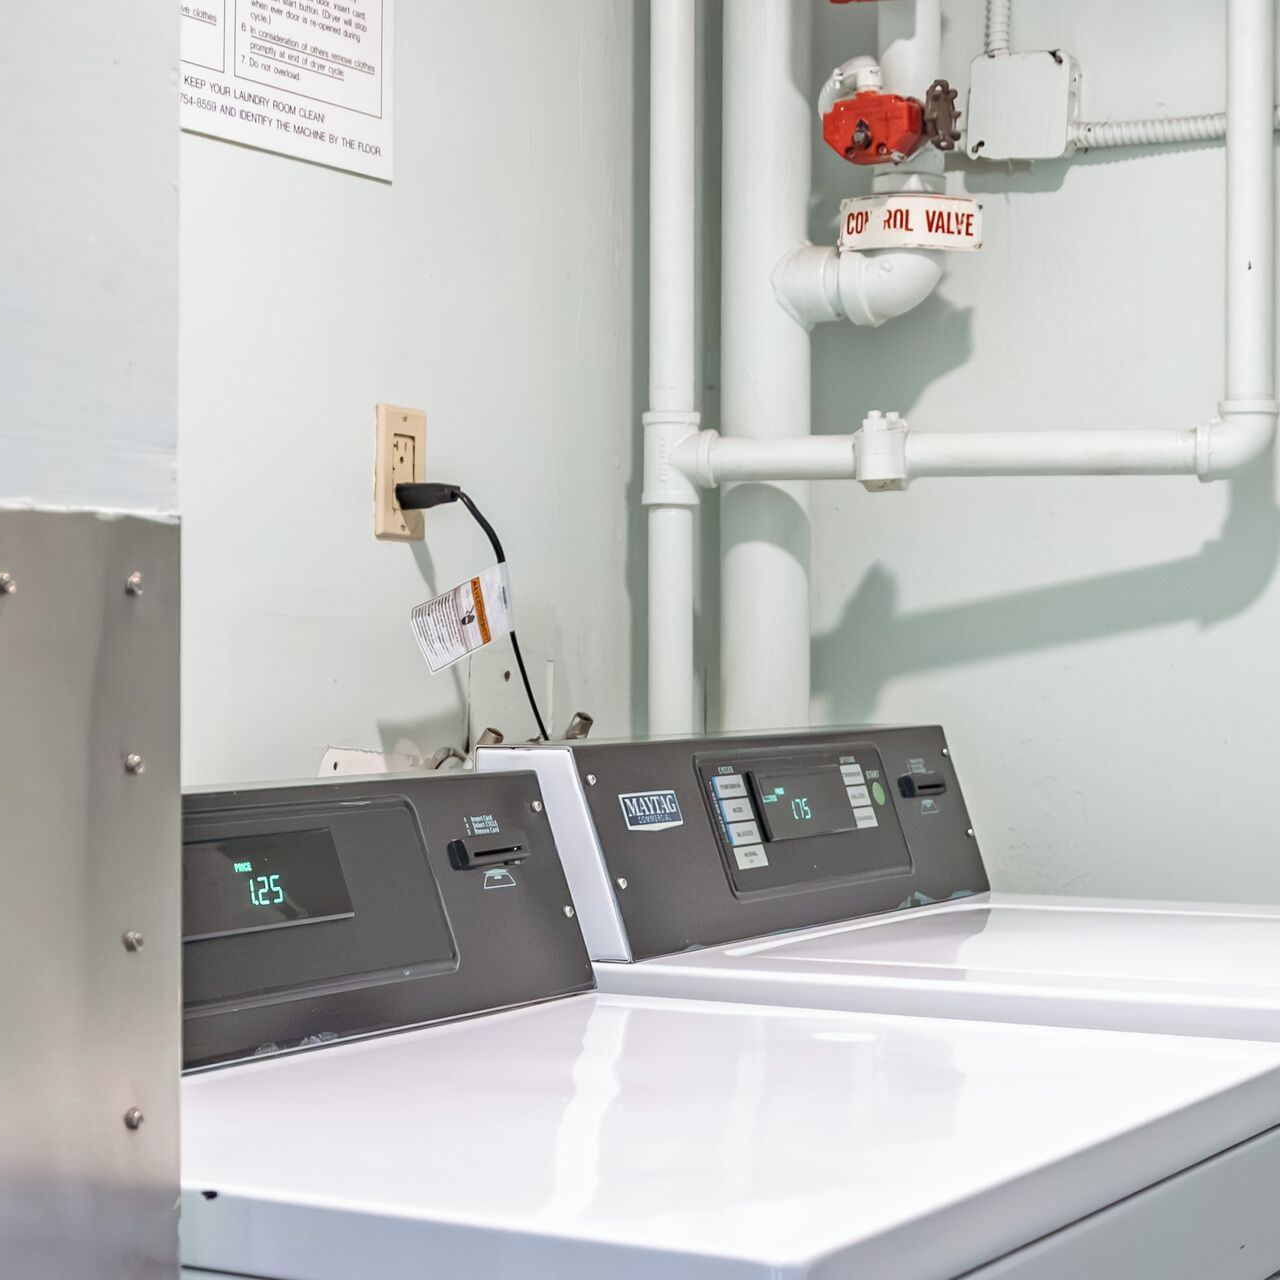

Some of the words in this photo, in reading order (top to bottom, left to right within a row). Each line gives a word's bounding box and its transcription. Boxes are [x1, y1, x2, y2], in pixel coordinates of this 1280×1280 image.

[192, 7, 217, 23] clothes
[270, 6, 283, 16] ever
[286, 10, 300, 21] door
[249, 57, 259, 69] Do
[261, 62, 271, 72] not
[288, 54, 300, 64] end
[310, 60, 326, 72] dryer
[310, 44, 329, 59] others
[354, 60, 375, 73] clothes
[184, 75, 206, 90] KEEP
[209, 82, 231, 97] YOUR
[234, 89, 270, 108] LAUNDRY
[272, 100, 296, 115] ROOM
[298, 107, 326, 124] CLEAN!
[219, 104, 237, 118] AND
[239, 109, 273, 128] IDENTIFY
[276, 119, 291, 133] THE
[293, 123, 326, 143] MACHINE
[328, 133, 339, 145] BY
[342, 136, 356, 150] THE
[357, 141, 382, 158] FLOOR.
[925, 209, 974, 236] VALVE
[624, 794, 677, 818] MAYTAG
